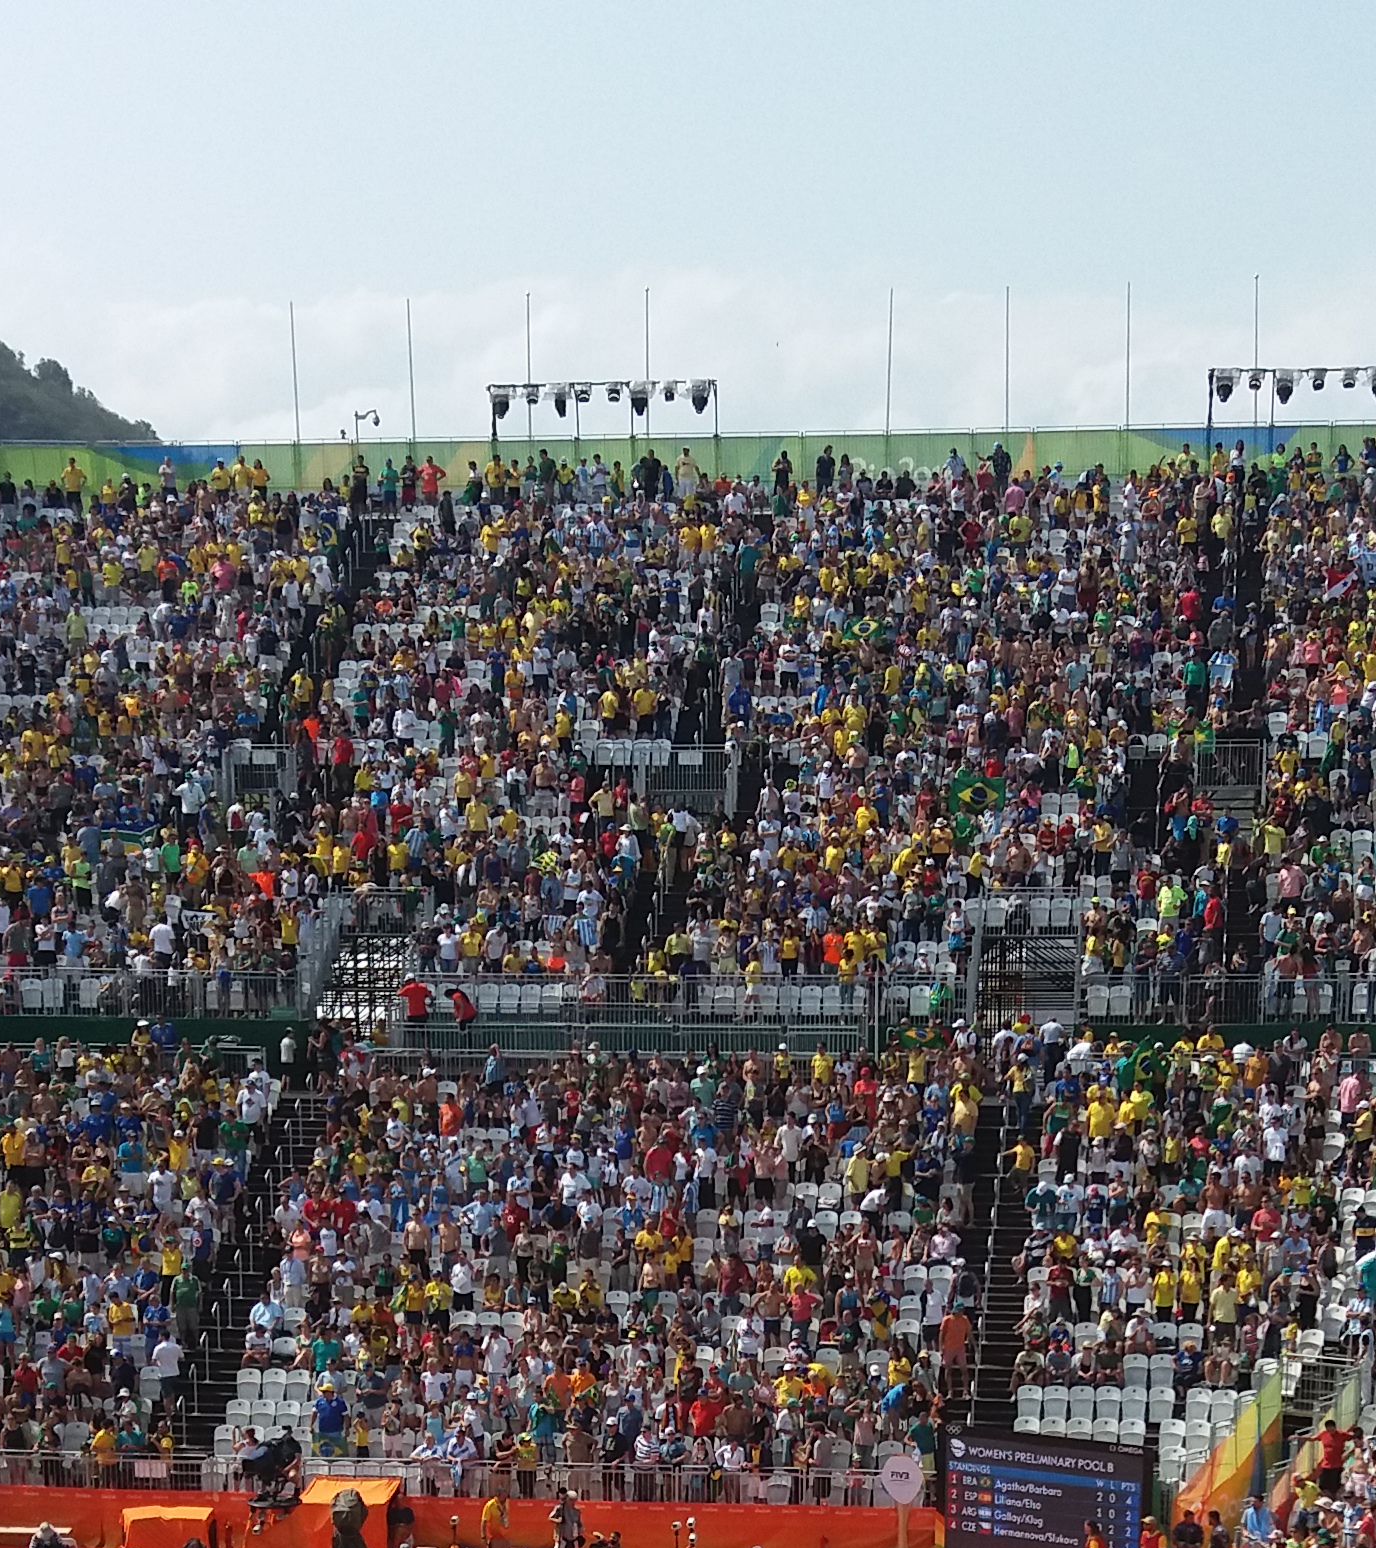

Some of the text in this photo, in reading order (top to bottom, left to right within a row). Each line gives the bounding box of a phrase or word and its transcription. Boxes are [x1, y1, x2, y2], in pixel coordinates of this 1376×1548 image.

[949, 1461, 991, 1474] STANDINGS
[968, 1446, 1114, 1473] WOMEN'S PRELIMINARY POOL B
[952, 1474, 1132, 1504] 1 BRA Agatha/Barbara 2 0 4
[1096, 1479, 1135, 1492] W L PTS
[951, 1489, 957, 1499] 2
[964, 1491, 977, 1501] ESP
[1096, 1508, 1102, 1517] 1
[1109, 1509, 1115, 1519] 0
[1126, 1511, 1132, 1521] 2
[950, 1521, 956, 1529] 4
[961, 1522, 977, 1532] CZE
[951, 1505, 957, 1514] 3
[961, 1507, 977, 1517] ARG
[1108, 1525, 1114, 1534] 2
[1125, 1527, 1131, 1537] 2
